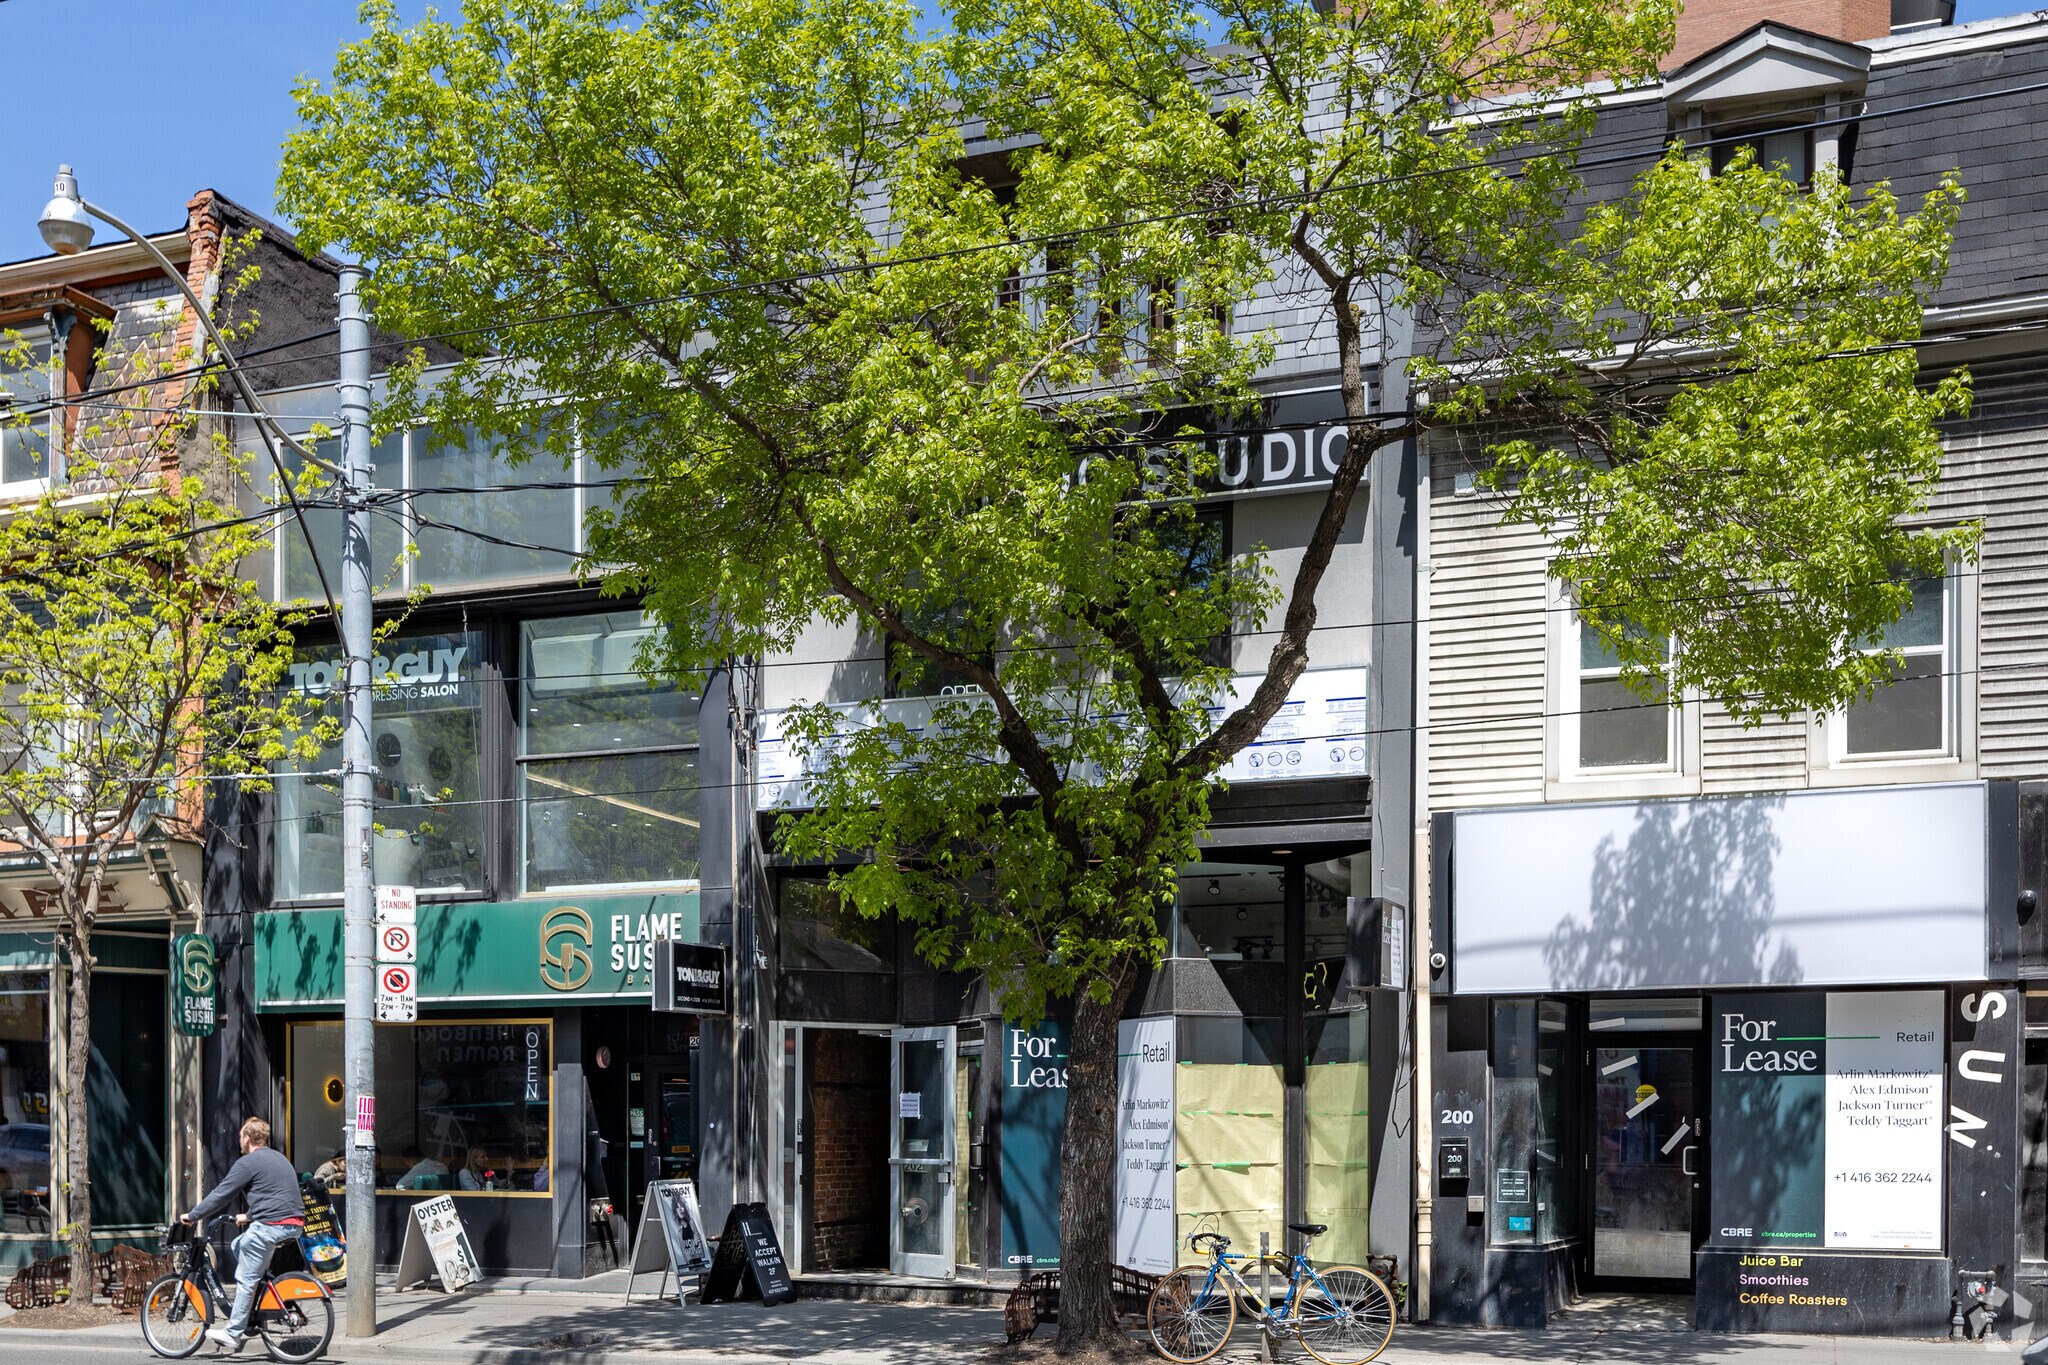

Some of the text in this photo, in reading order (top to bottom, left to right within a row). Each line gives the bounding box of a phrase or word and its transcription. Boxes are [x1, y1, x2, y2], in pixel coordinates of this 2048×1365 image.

[421, 684, 459, 698] SALON
[392, 888, 401, 898] NO
[381, 900, 413, 910] STANDING
[611, 913, 682, 942] FLAME
[611, 942, 653, 971] SUS
[627, 974, 651, 984] BA
[677, 966, 720, 984] TONI&GUY
[184, 996, 214, 1010] FLAME
[381, 994, 393, 1002] 7AM
[400, 994, 413, 1002] 11AM
[380, 1003, 393, 1011] 2PM
[401, 1003, 413, 1011] 7PM
[184, 1010, 214, 1024] SUSHI
[1721, 1013, 1777, 1042] For
[1896, 1031, 1934, 1043] Retail
[1010, 1029, 1057, 1058] For
[1142, 1041, 1170, 1063] Retail
[1721, 1044, 1818, 1072] Lease
[525, 1032, 539, 1099] OPEN
[1010, 1059, 1069, 1088] Leas
[1835, 1069, 1864, 1080] Arlin
[1849, 1084, 1875, 1095] Alex
[1121, 1099, 1136, 1110] Arlin
[1838, 1100, 1881, 1112] Jackson
[1441, 1109, 1474, 1124] 200
[1846, 1115, 1882, 1128] Teddy
[1129, 1119, 1141, 1130] Alex
[1122, 1138, 1144, 1151] Jackson
[1126, 1158, 1144, 1172] Teddy
[1447, 1155, 1462, 1163] 200
[905, 1163, 922, 1171] 202
[1834, 1172, 1932, 1183] +1 416 362 2244
[417, 1199, 454, 1220] OYSTER
[1129, 1197, 1140, 1208] 416
[1141, 1197, 1153, 1210] 362
[1154, 1198, 1170, 1210] 2244
[1720, 1227, 1817, 1239] CBRE cbre.ca/properties
[757, 1238, 768, 1246] WE
[755, 1247, 777, 1257] ACCEPT
[757, 1257, 781, 1267] WALK-IN
[1007, 1255, 1060, 1264] CBRE cbre.ca/pr
[1739, 1255, 1804, 1267] Juice Bar
[768, 1267, 776, 1276] 2F
[1739, 1274, 1809, 1286] Smoothies
[1739, 1292, 1848, 1306] Coffee Roasters
